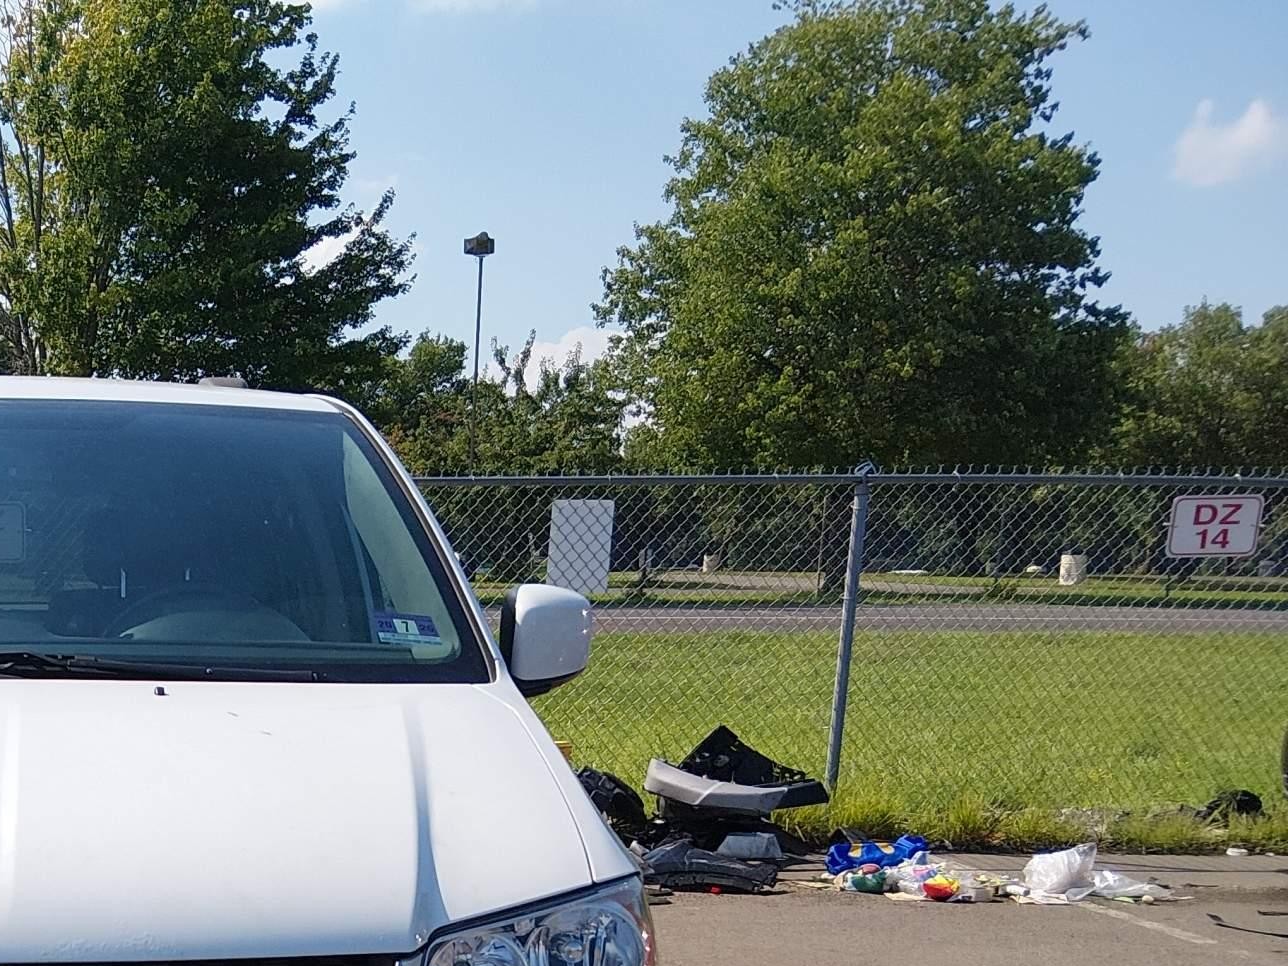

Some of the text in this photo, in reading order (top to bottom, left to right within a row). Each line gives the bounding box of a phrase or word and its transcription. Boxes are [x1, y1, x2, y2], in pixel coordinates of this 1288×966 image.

[1192, 503, 1244, 526] DZ
[1195, 528, 1230, 550] 14
[400, 620, 410, 633] 7
